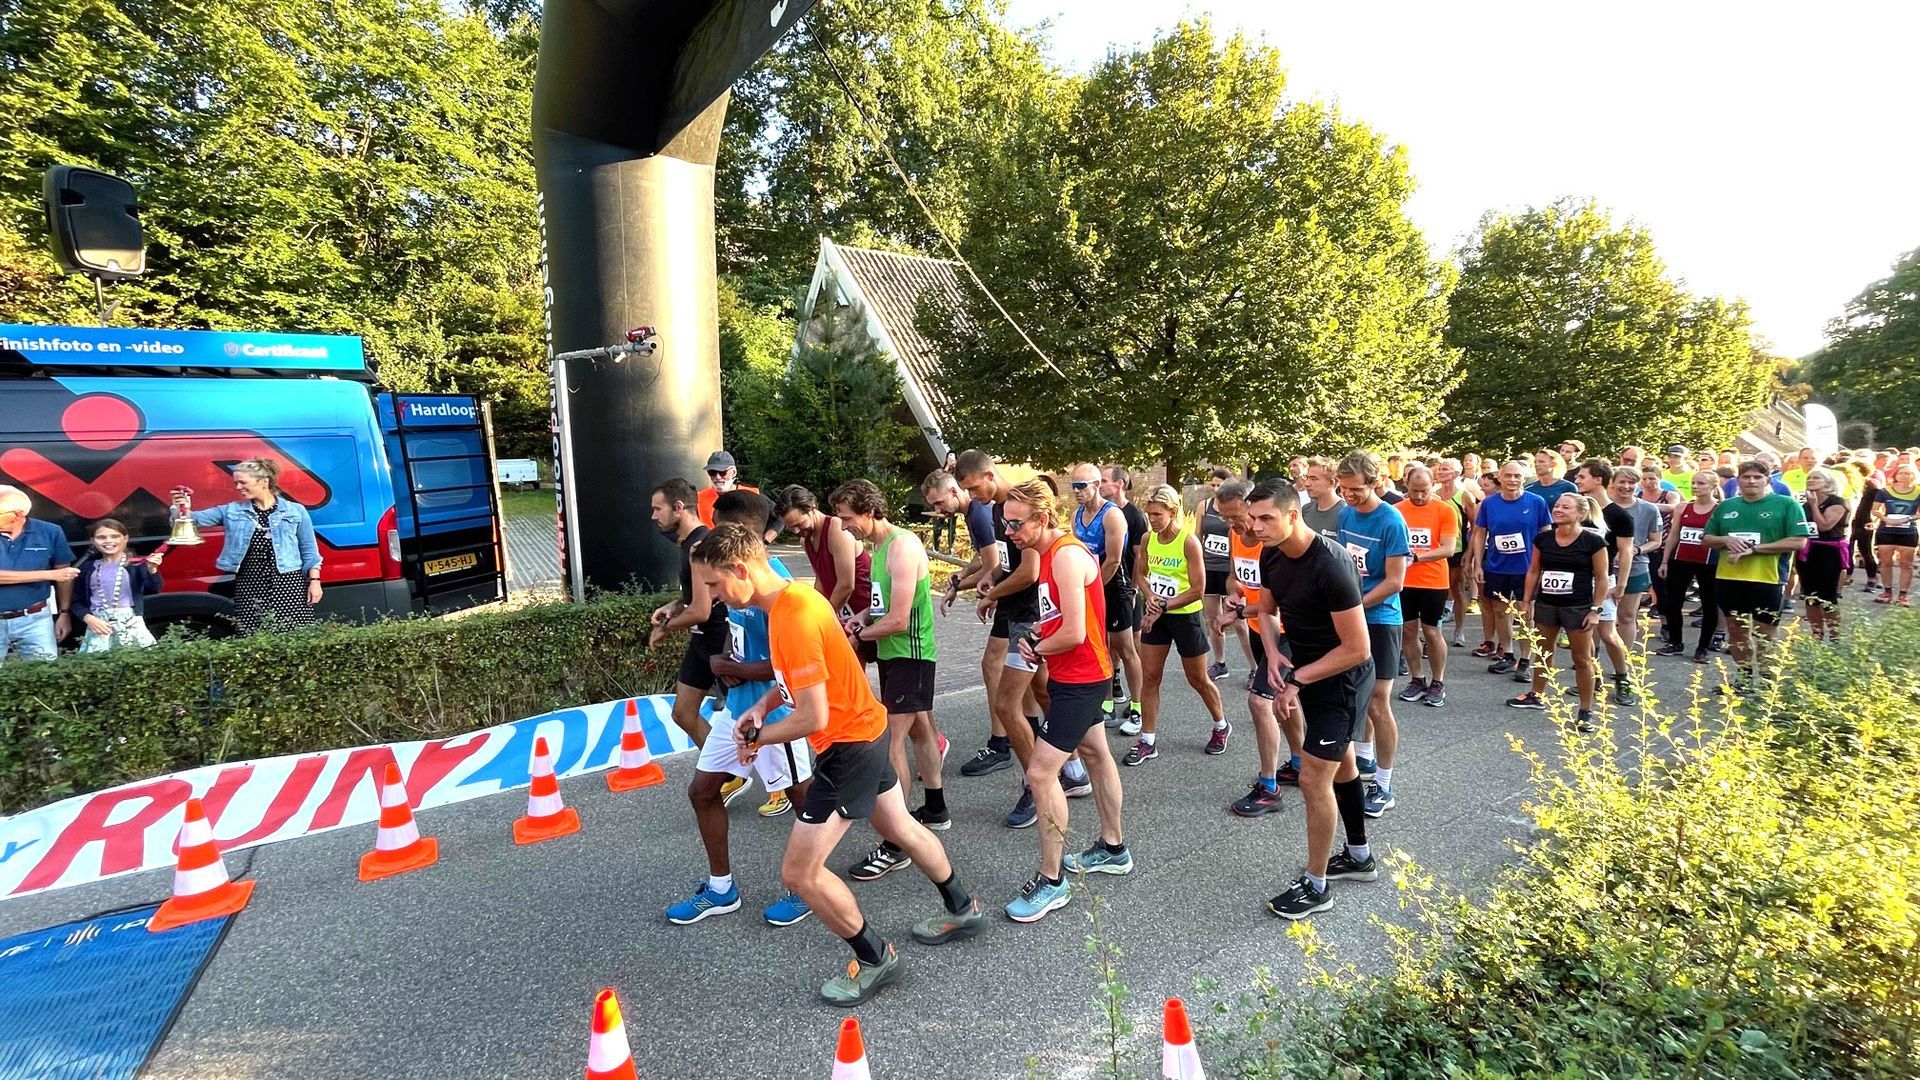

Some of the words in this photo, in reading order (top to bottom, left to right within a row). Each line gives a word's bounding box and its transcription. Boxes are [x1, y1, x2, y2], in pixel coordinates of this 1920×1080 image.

[97, 341, 121, 353] en
[125, 340, 185, 355] -video
[1207, 540, 1228, 551] 178
[1501, 540, 1518, 550] 99
[427, 554, 474, 571] V-545-HJ
[1237, 566, 1257, 582] 161
[1152, 581, 1176, 597] 170
[1544, 578, 1570, 589] 207
